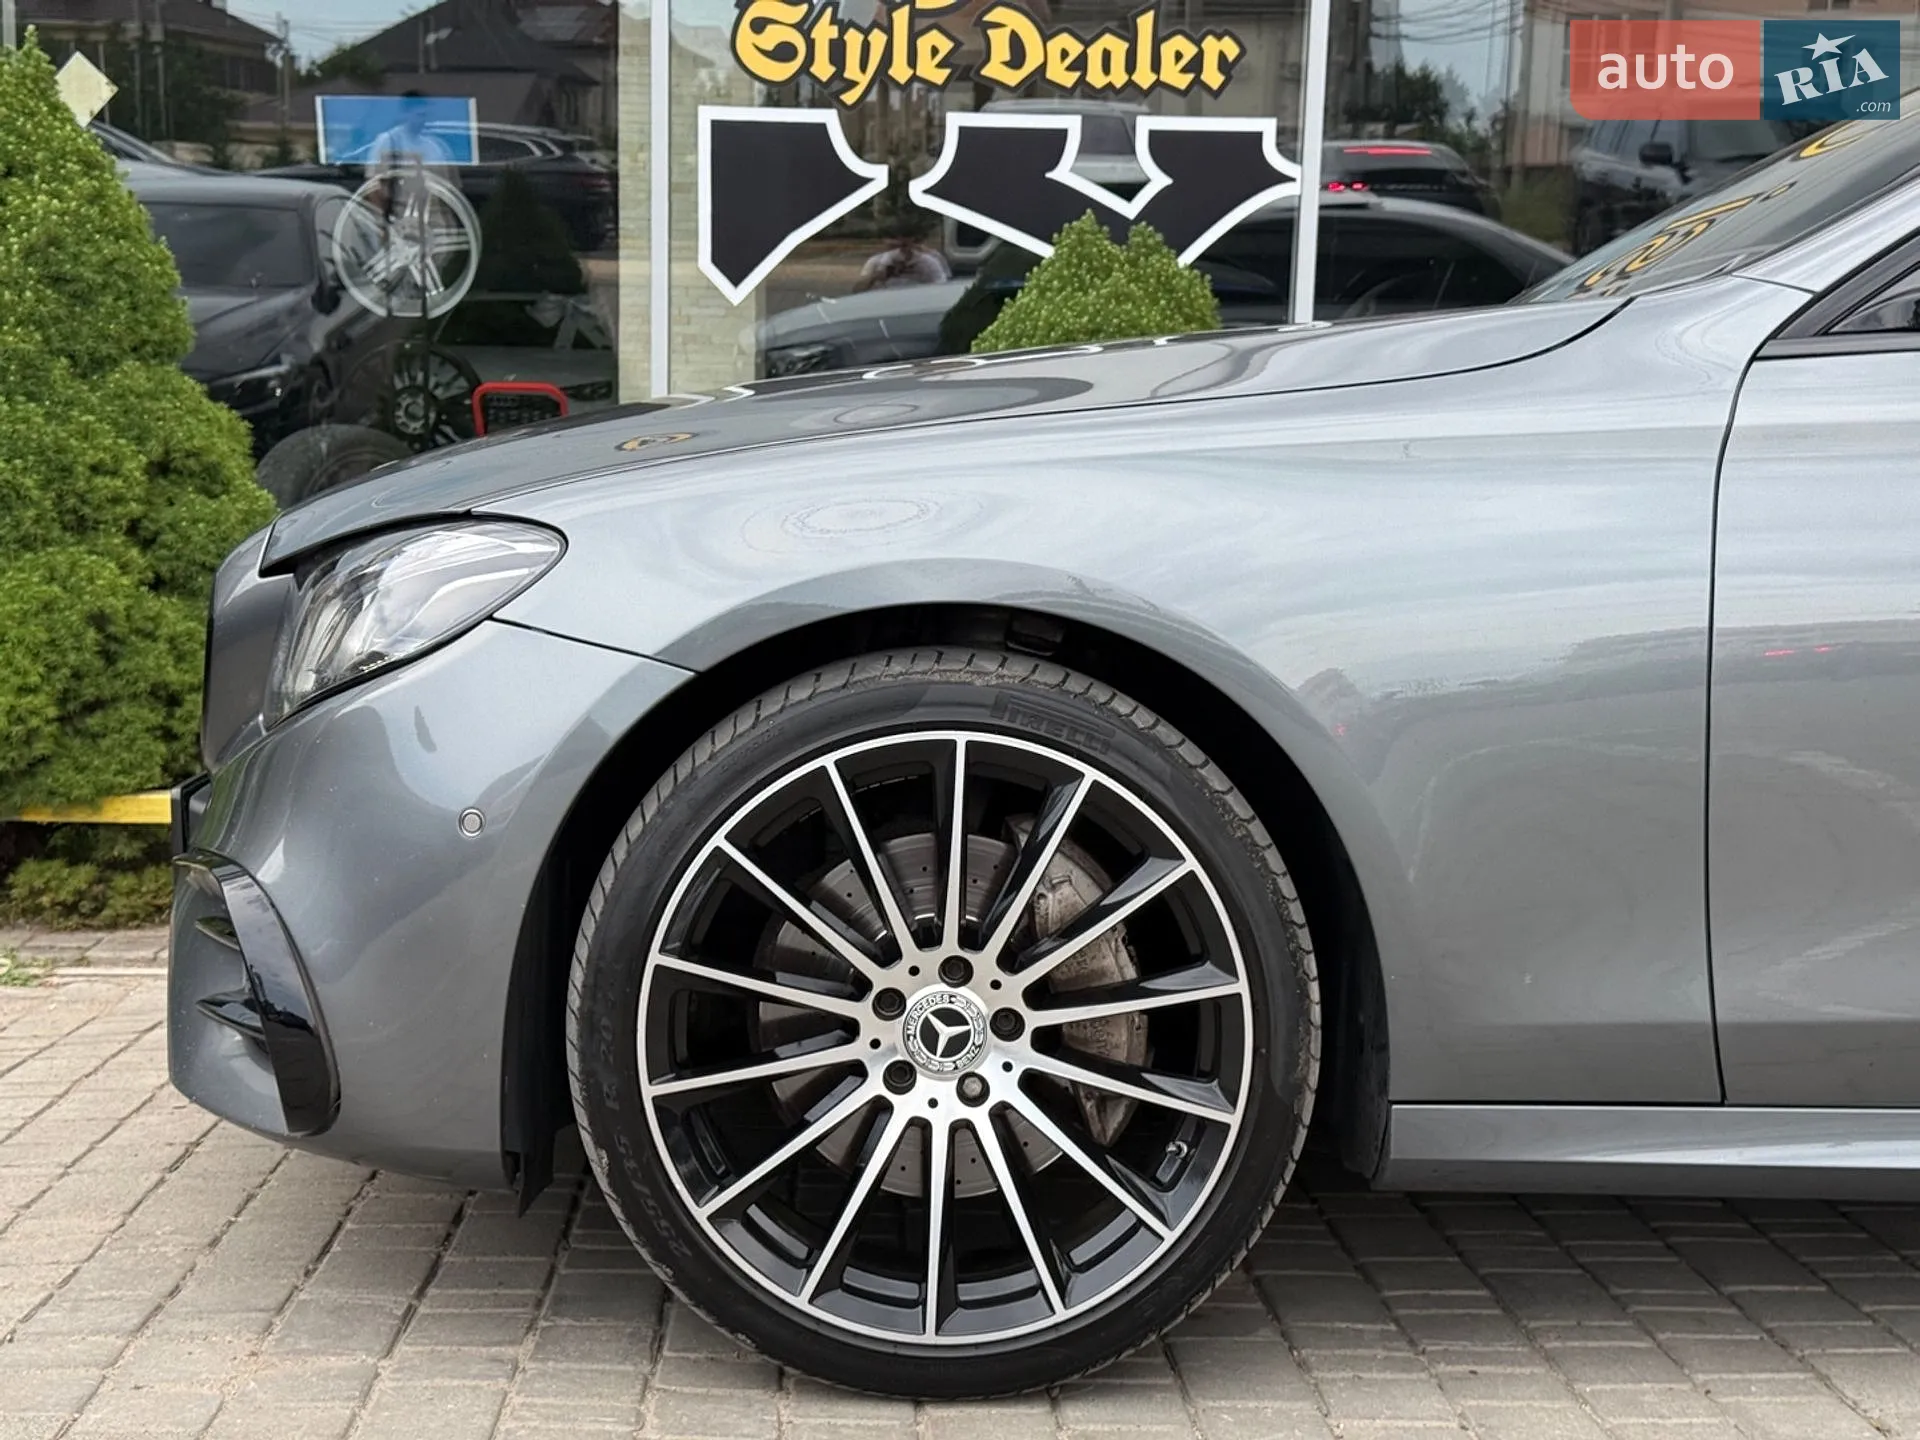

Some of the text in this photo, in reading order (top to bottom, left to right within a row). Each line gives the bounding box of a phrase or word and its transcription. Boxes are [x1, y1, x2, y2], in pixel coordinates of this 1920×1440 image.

[734, 0, 1241, 106] Style Dealer
[990, 692, 1116, 755] PIRELLI
[905, 994, 950, 1035] MERCEDES
[956, 1046, 980, 1069] BENZ
